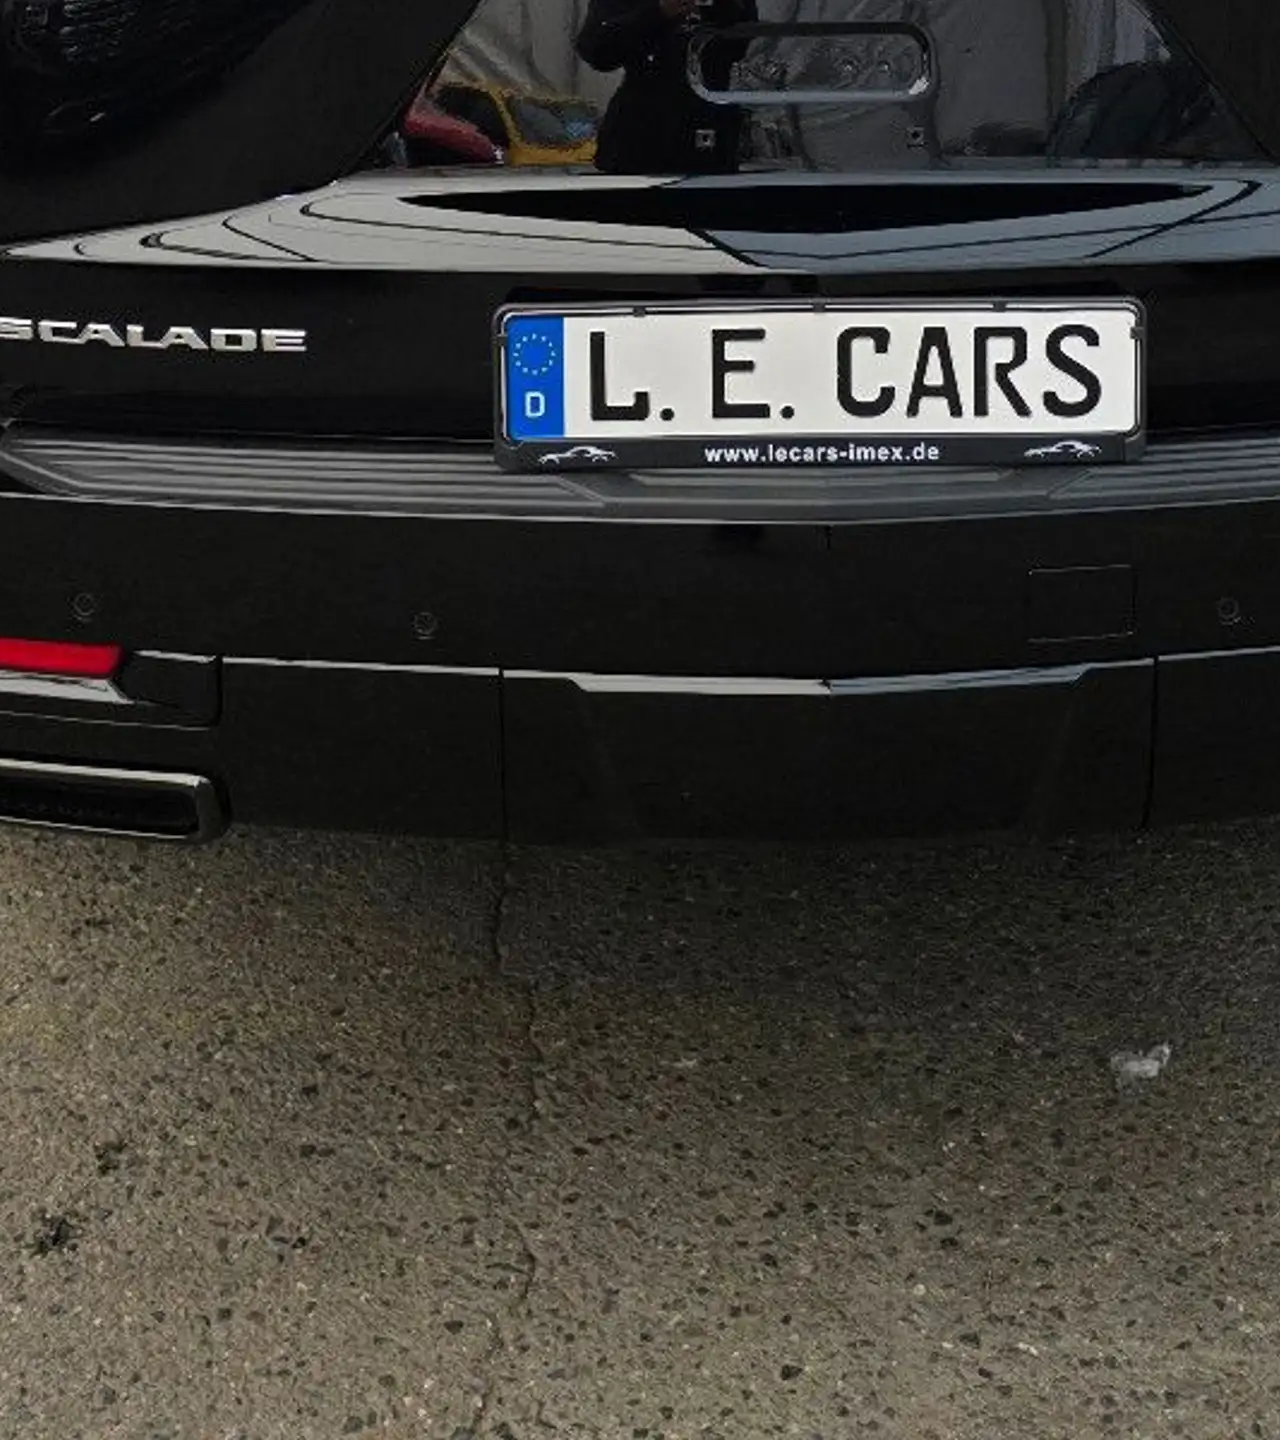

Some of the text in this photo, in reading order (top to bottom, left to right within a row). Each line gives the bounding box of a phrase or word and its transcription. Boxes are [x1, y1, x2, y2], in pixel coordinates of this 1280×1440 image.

[590, 324, 1102, 421] L. E. CARS
[524, 391, 546, 418] D
[704, 442, 941, 463] www.lecars-imex.de
